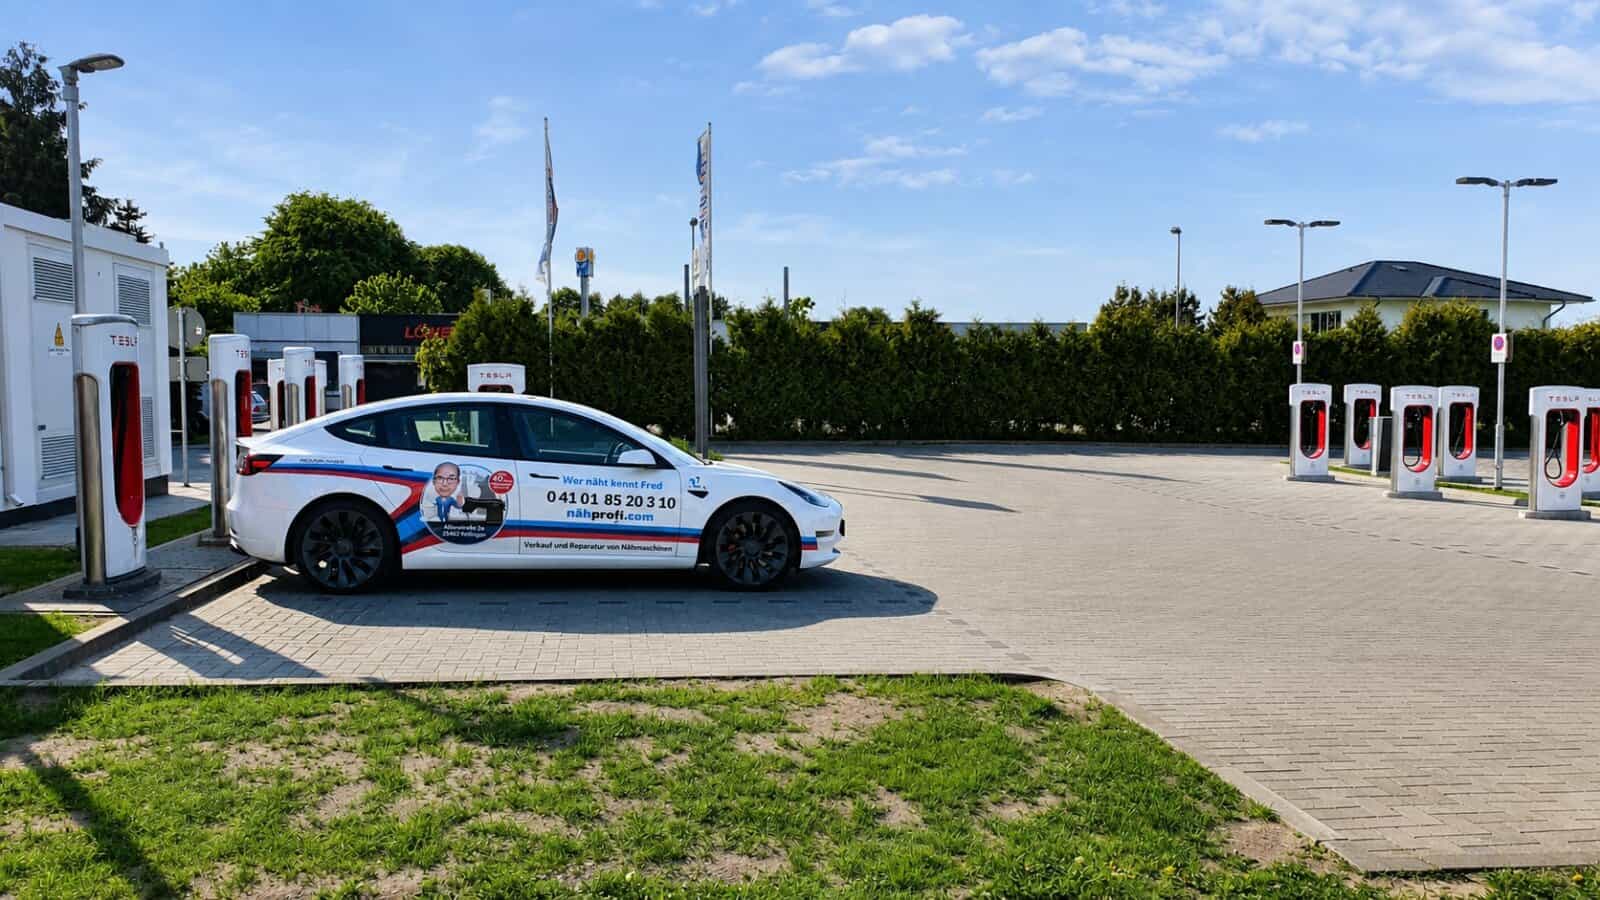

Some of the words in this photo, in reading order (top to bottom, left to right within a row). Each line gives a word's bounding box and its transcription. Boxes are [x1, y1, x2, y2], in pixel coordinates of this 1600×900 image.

[563, 475, 583, 486] Wer
[585, 478, 609, 488] näht
[611, 478, 640, 490] kennt
[641, 480, 664, 490] Fred
[547, 491, 557, 503] 0
[580, 492, 599, 505] 01
[604, 494, 622, 506] 85
[625, 495, 643, 507] 20
[566, 508, 654, 522] nähprofi.com
[524, 541, 553, 549] Verkauf
[554, 542, 569, 550] und
[570, 542, 605, 552] Reparatur
[621, 544, 673, 553] Nähmaschinen
